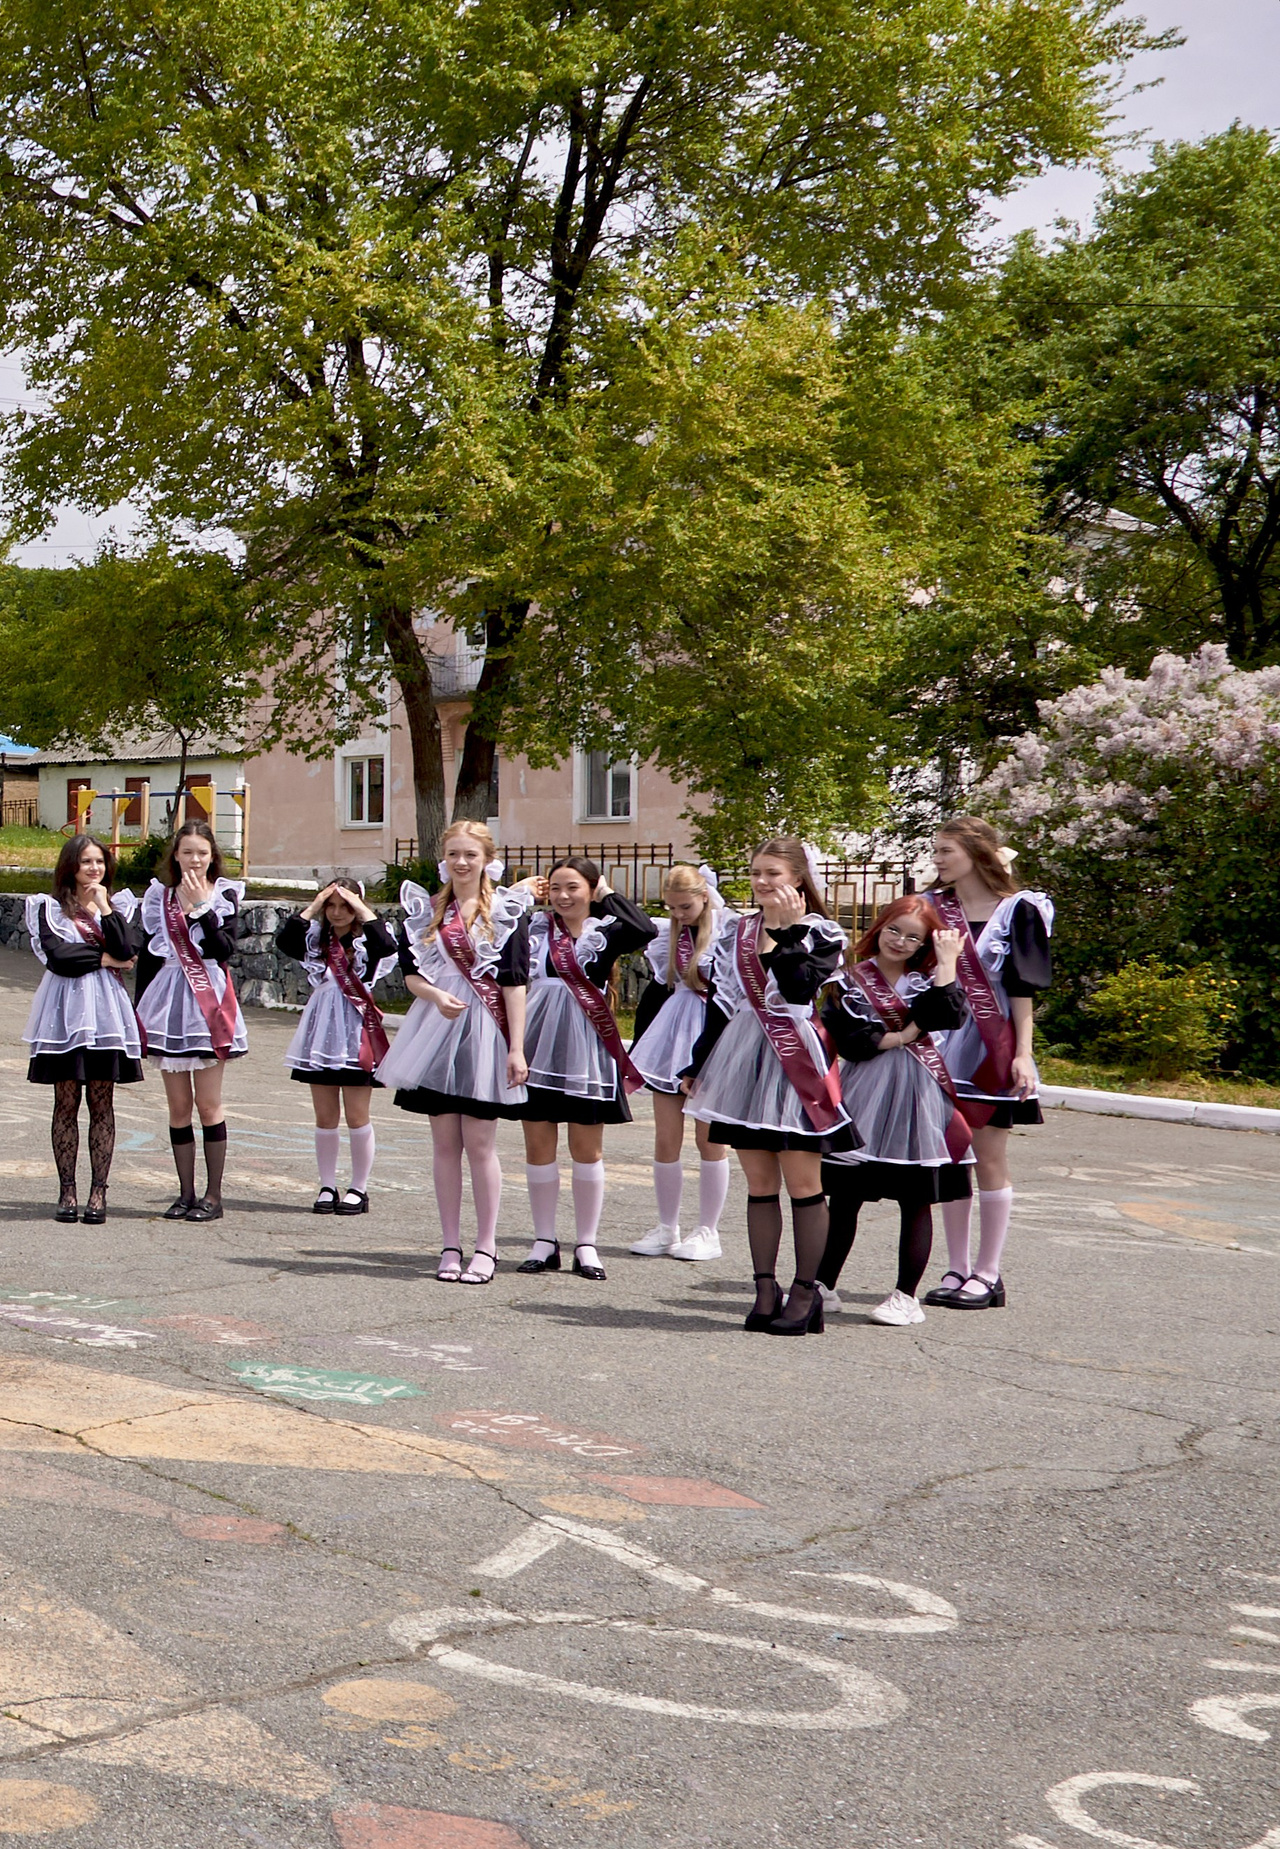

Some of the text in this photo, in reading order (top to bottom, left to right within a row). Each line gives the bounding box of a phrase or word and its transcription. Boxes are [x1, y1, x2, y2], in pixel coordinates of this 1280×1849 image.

[184, 964, 211, 992] 2026
[482, 990, 506, 1025] 202
[964, 983, 999, 1019] 2026
[586, 1004, 615, 1038] 2026
[765, 1019, 804, 1057] 2026
[920, 1049, 948, 1086] 2026
